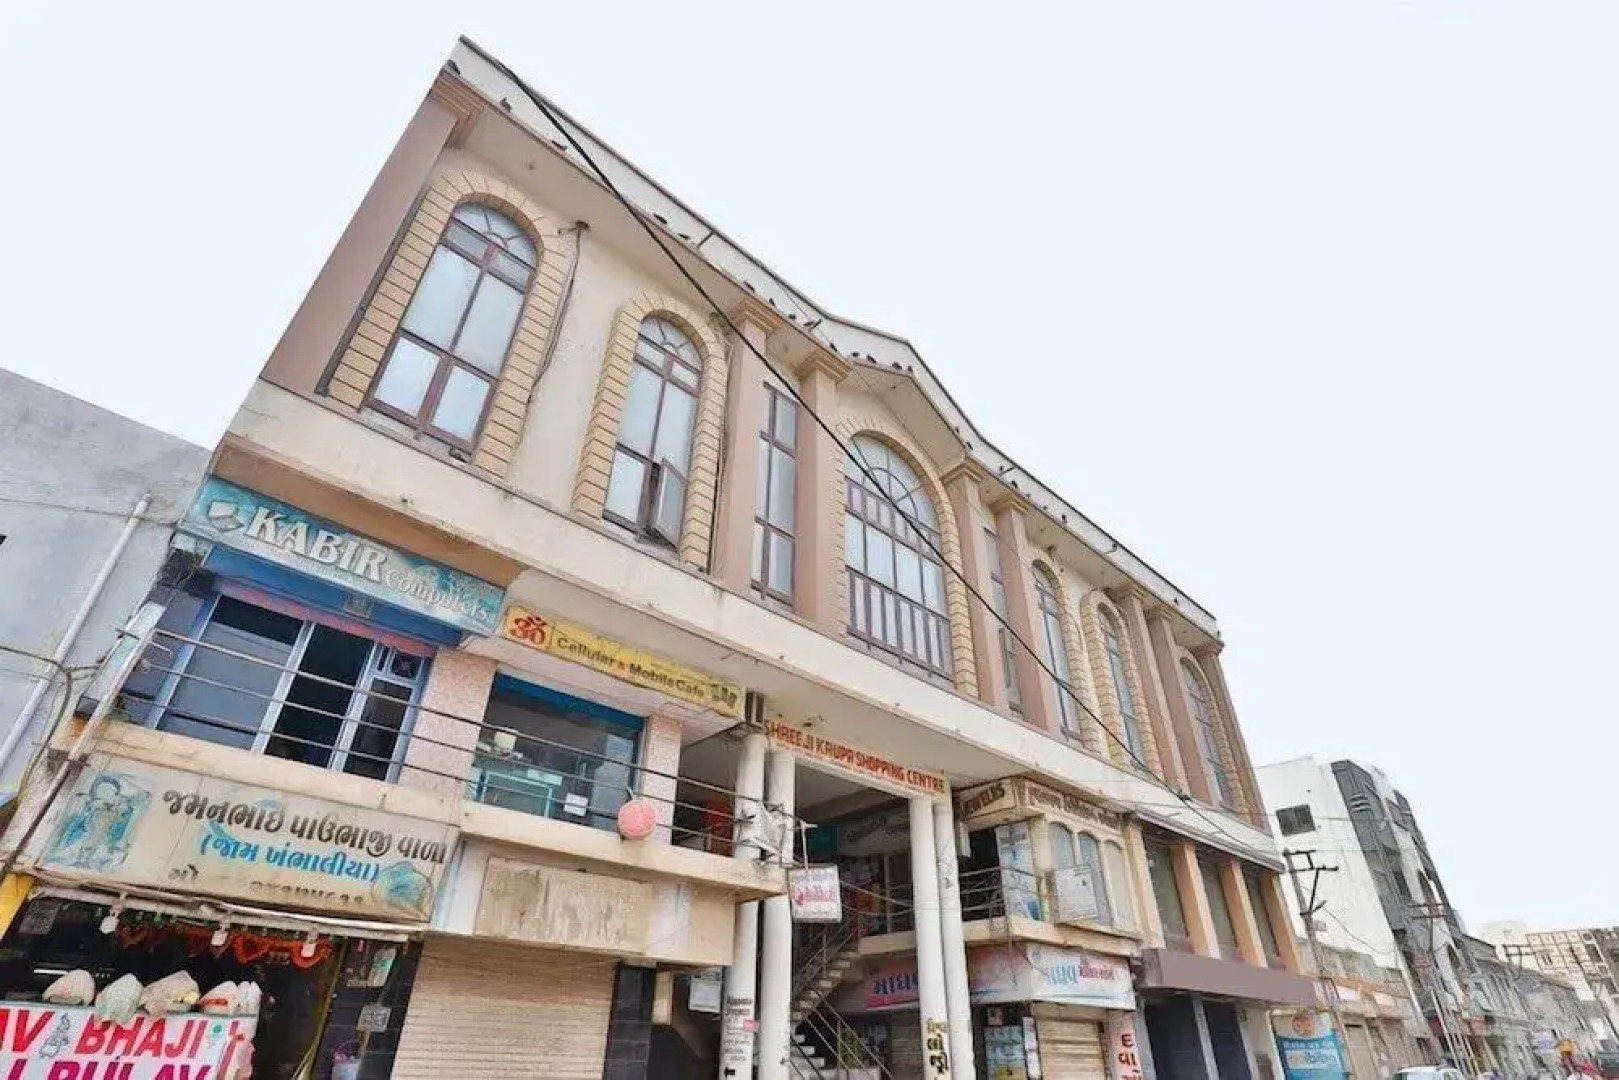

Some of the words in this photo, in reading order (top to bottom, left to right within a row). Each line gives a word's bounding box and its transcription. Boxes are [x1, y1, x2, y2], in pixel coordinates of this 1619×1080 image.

[245, 506, 388, 583] KABIR
[557, 637, 617, 668] Cellular
[675, 679, 705, 697] Cafe
[764, 718, 813, 751] SHREEJI
[855, 751, 904, 781] SHOPPING
[906, 769, 945, 794] CENTRE
[397, 836, 448, 864] વાળા
[74, 1013, 208, 1058] BHAJI
